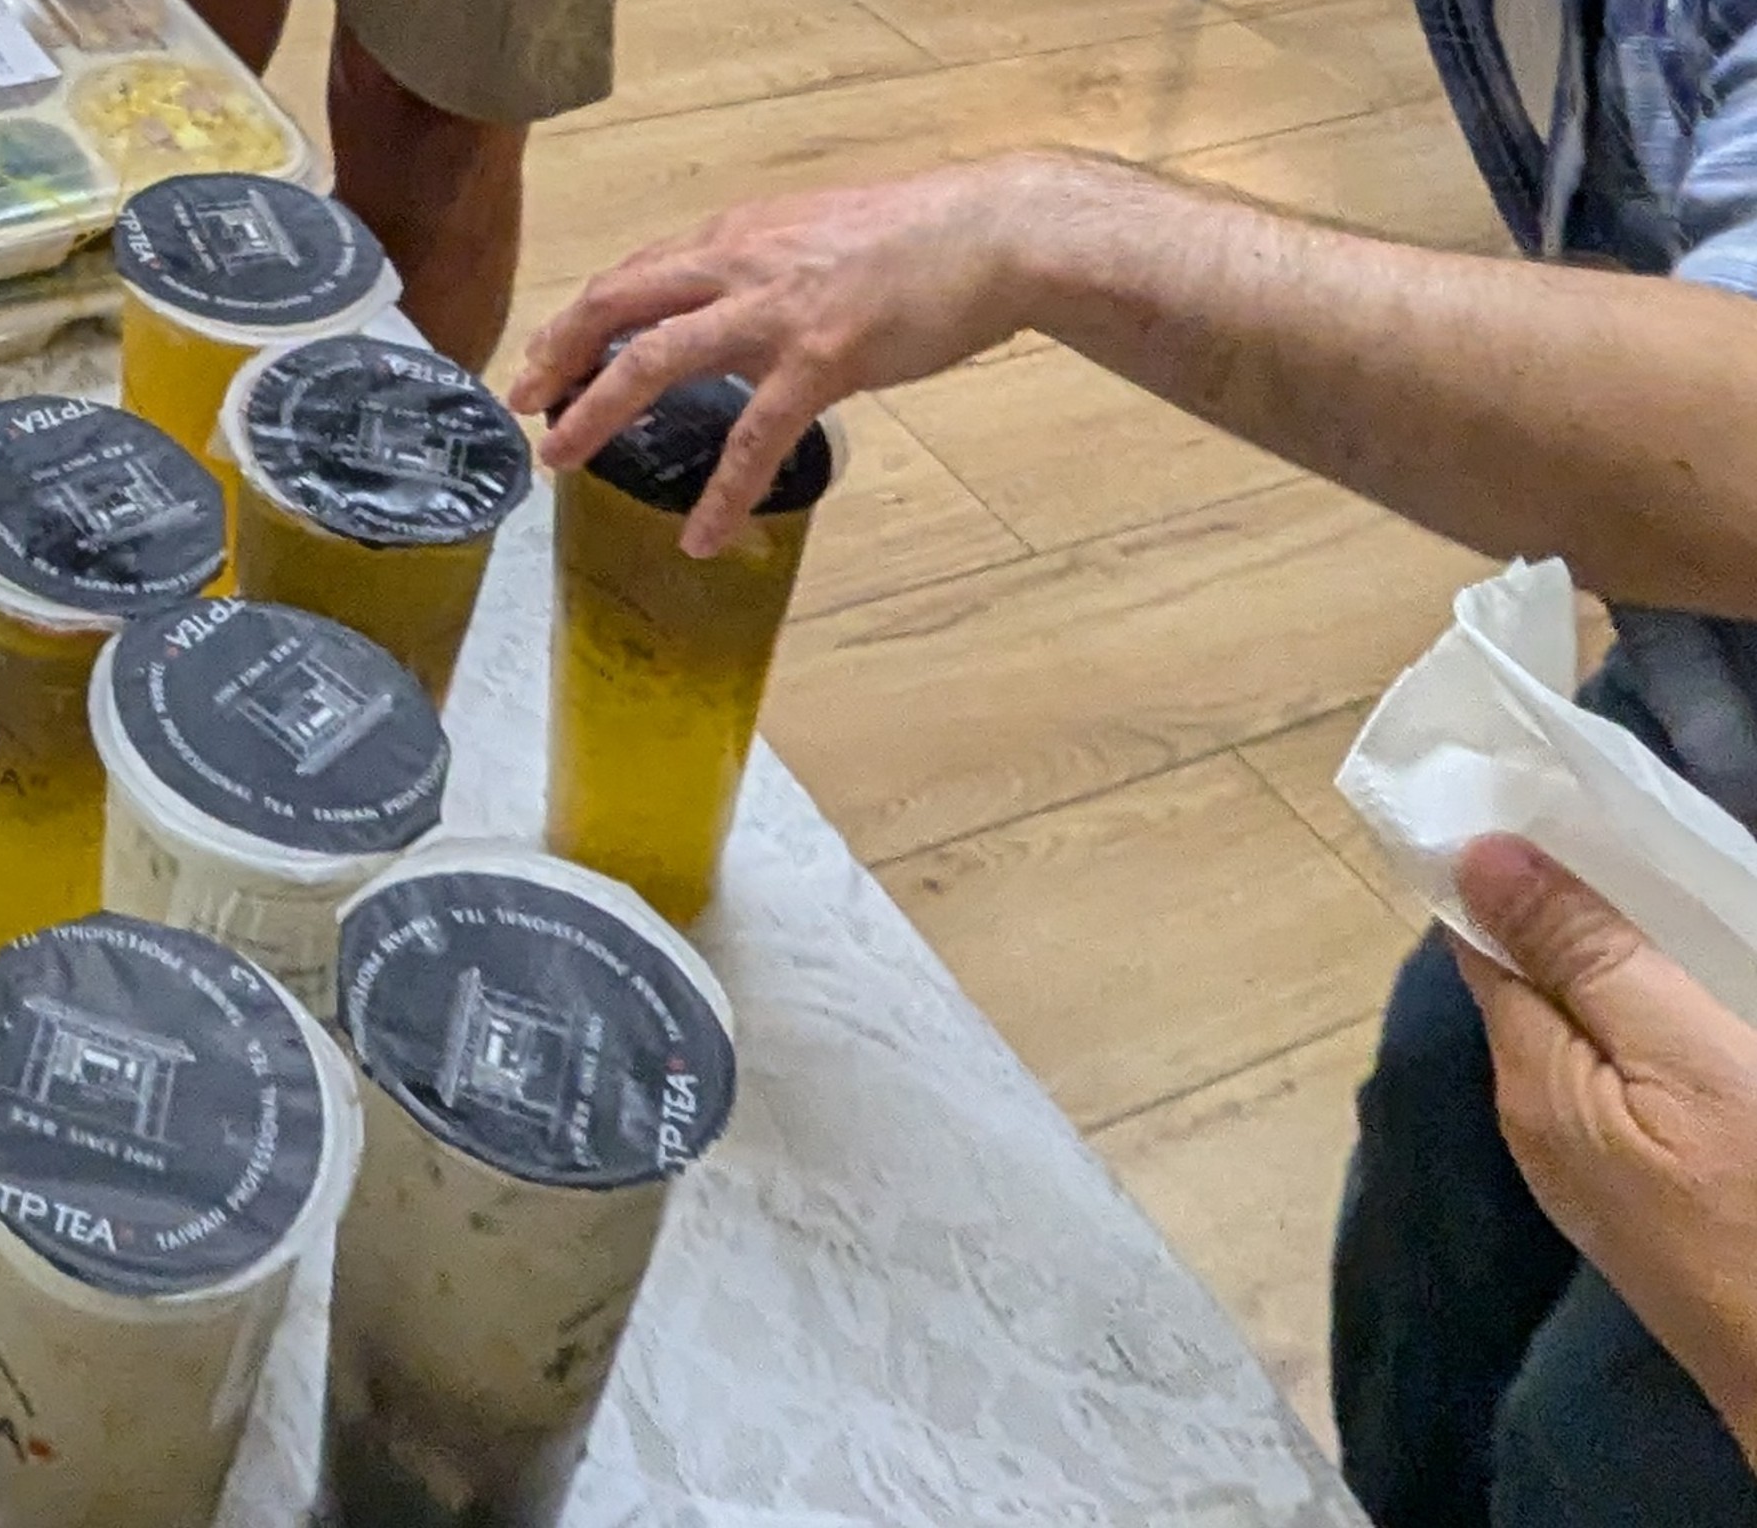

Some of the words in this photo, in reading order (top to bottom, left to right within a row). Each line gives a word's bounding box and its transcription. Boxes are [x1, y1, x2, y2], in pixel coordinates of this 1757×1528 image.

[10, 407, 63, 434] TEA
[60, 396, 100, 420] TP
[208, 595, 247, 625] TP
[162, 614, 215, 650] TEA
[451, 908, 487, 924] TEA
[662, 1073, 700, 1125] TEA
[656, 1122, 691, 1171] TP
[155, 1205, 228, 1252] TAIWAN
[225, 1085, 280, 1212] PROFESSIONAL
[52, 1202, 117, 1254] TEA
